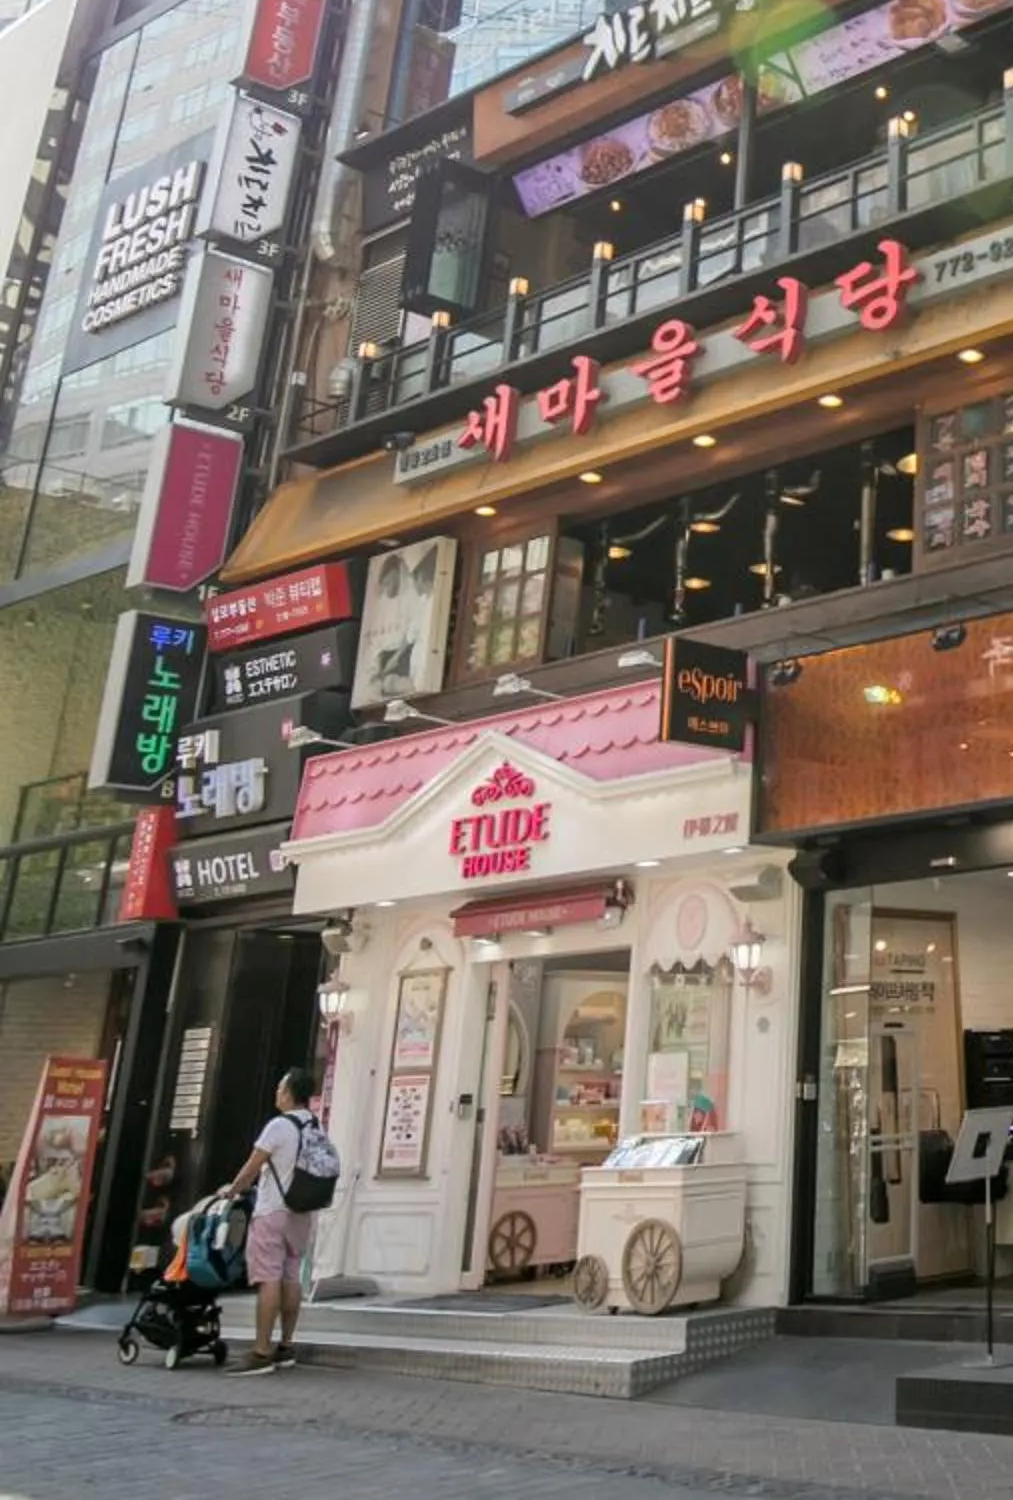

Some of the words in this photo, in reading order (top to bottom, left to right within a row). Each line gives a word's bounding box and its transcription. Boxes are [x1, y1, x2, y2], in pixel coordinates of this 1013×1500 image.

[287, 89, 308, 106] 3F
[102, 160, 201, 242] LUSH
[93, 204, 194, 281] FRESH
[257, 240, 280, 256] 3F
[87, 246, 182, 308] HANDMADE
[82, 274, 178, 332] COSMETICS
[205, 266, 243, 397] 새마을식당
[456, 238, 918, 464] 새마을식당
[227, 404, 250, 423] 2F
[149, 624, 195, 653] 루키
[245, 650, 297, 678] ESTHETIC
[677, 667, 743, 705] espoir
[137, 655, 183, 775] 노래방
[177, 729, 220, 771] 루키
[174, 757, 268, 818] 노래방
[449, 803, 552, 855] ETUDE
[198, 851, 260, 887] HOTEL
[462, 846, 532, 879] HOUSE
